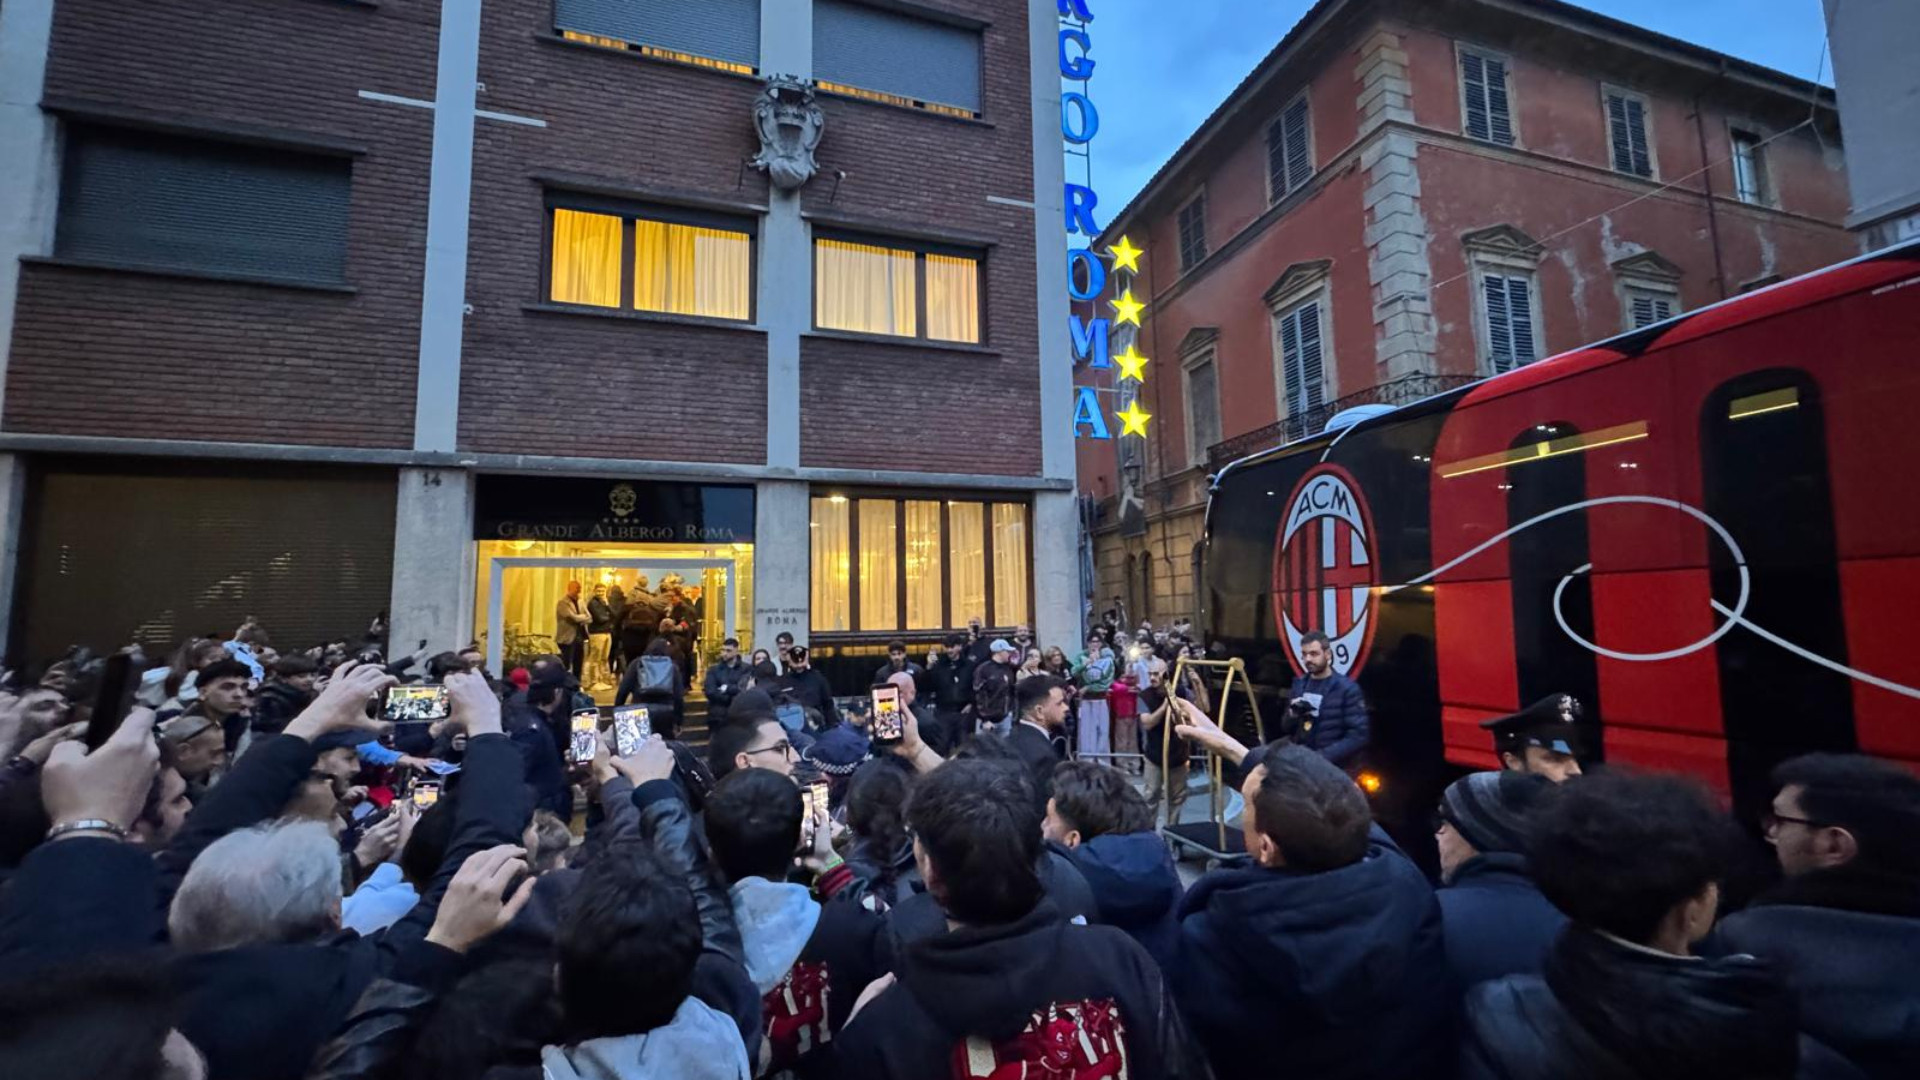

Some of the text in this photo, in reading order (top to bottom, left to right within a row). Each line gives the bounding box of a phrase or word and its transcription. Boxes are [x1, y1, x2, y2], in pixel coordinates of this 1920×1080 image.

[1065, 183, 1112, 440] ROMA
[422, 471, 442, 487] 14
[1294, 481, 1351, 526] ACM
[498, 521, 735, 539] GRANDE ALBERGO ROMA
[767, 616, 798, 625] ROMA
